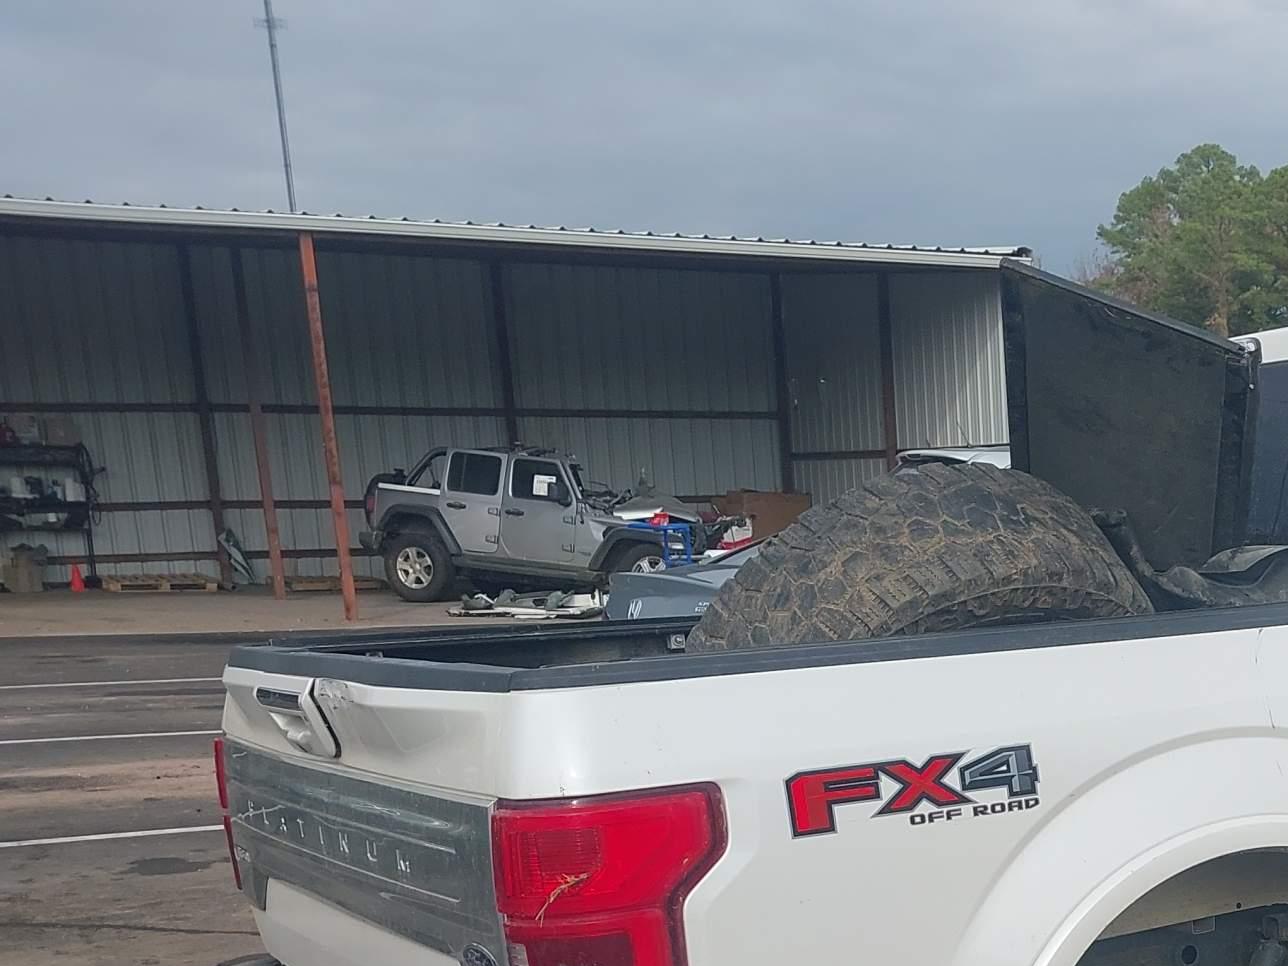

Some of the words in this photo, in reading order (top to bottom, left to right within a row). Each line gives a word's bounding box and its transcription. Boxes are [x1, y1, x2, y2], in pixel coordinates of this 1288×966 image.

[785, 743, 1040, 839] FX4
[909, 810, 962, 826] OFF
[972, 797, 1040, 817] ROAD
